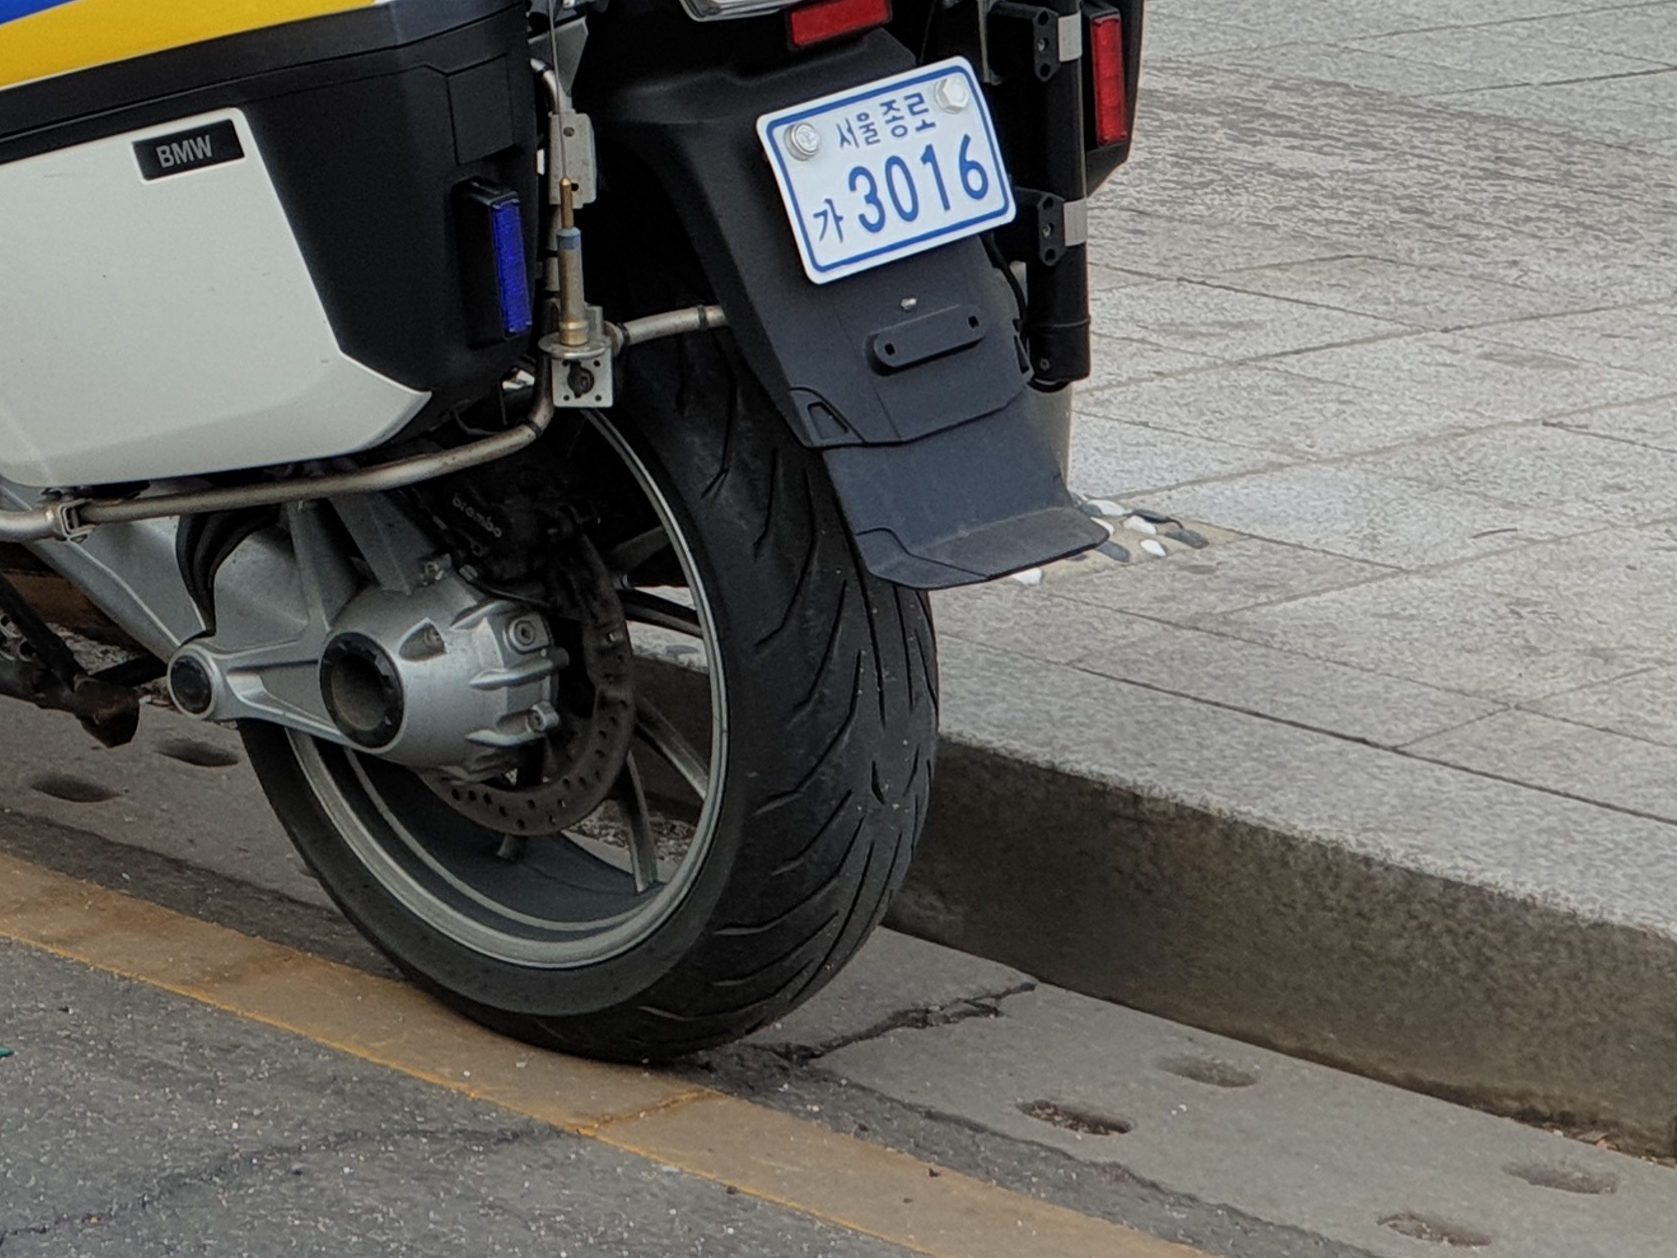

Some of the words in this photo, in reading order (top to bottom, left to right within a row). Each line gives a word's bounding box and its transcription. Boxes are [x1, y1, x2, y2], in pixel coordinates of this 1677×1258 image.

[836, 92, 937, 149] 서울종로
[156, 134, 213, 168] BMW
[848, 134, 989, 233] 3016
